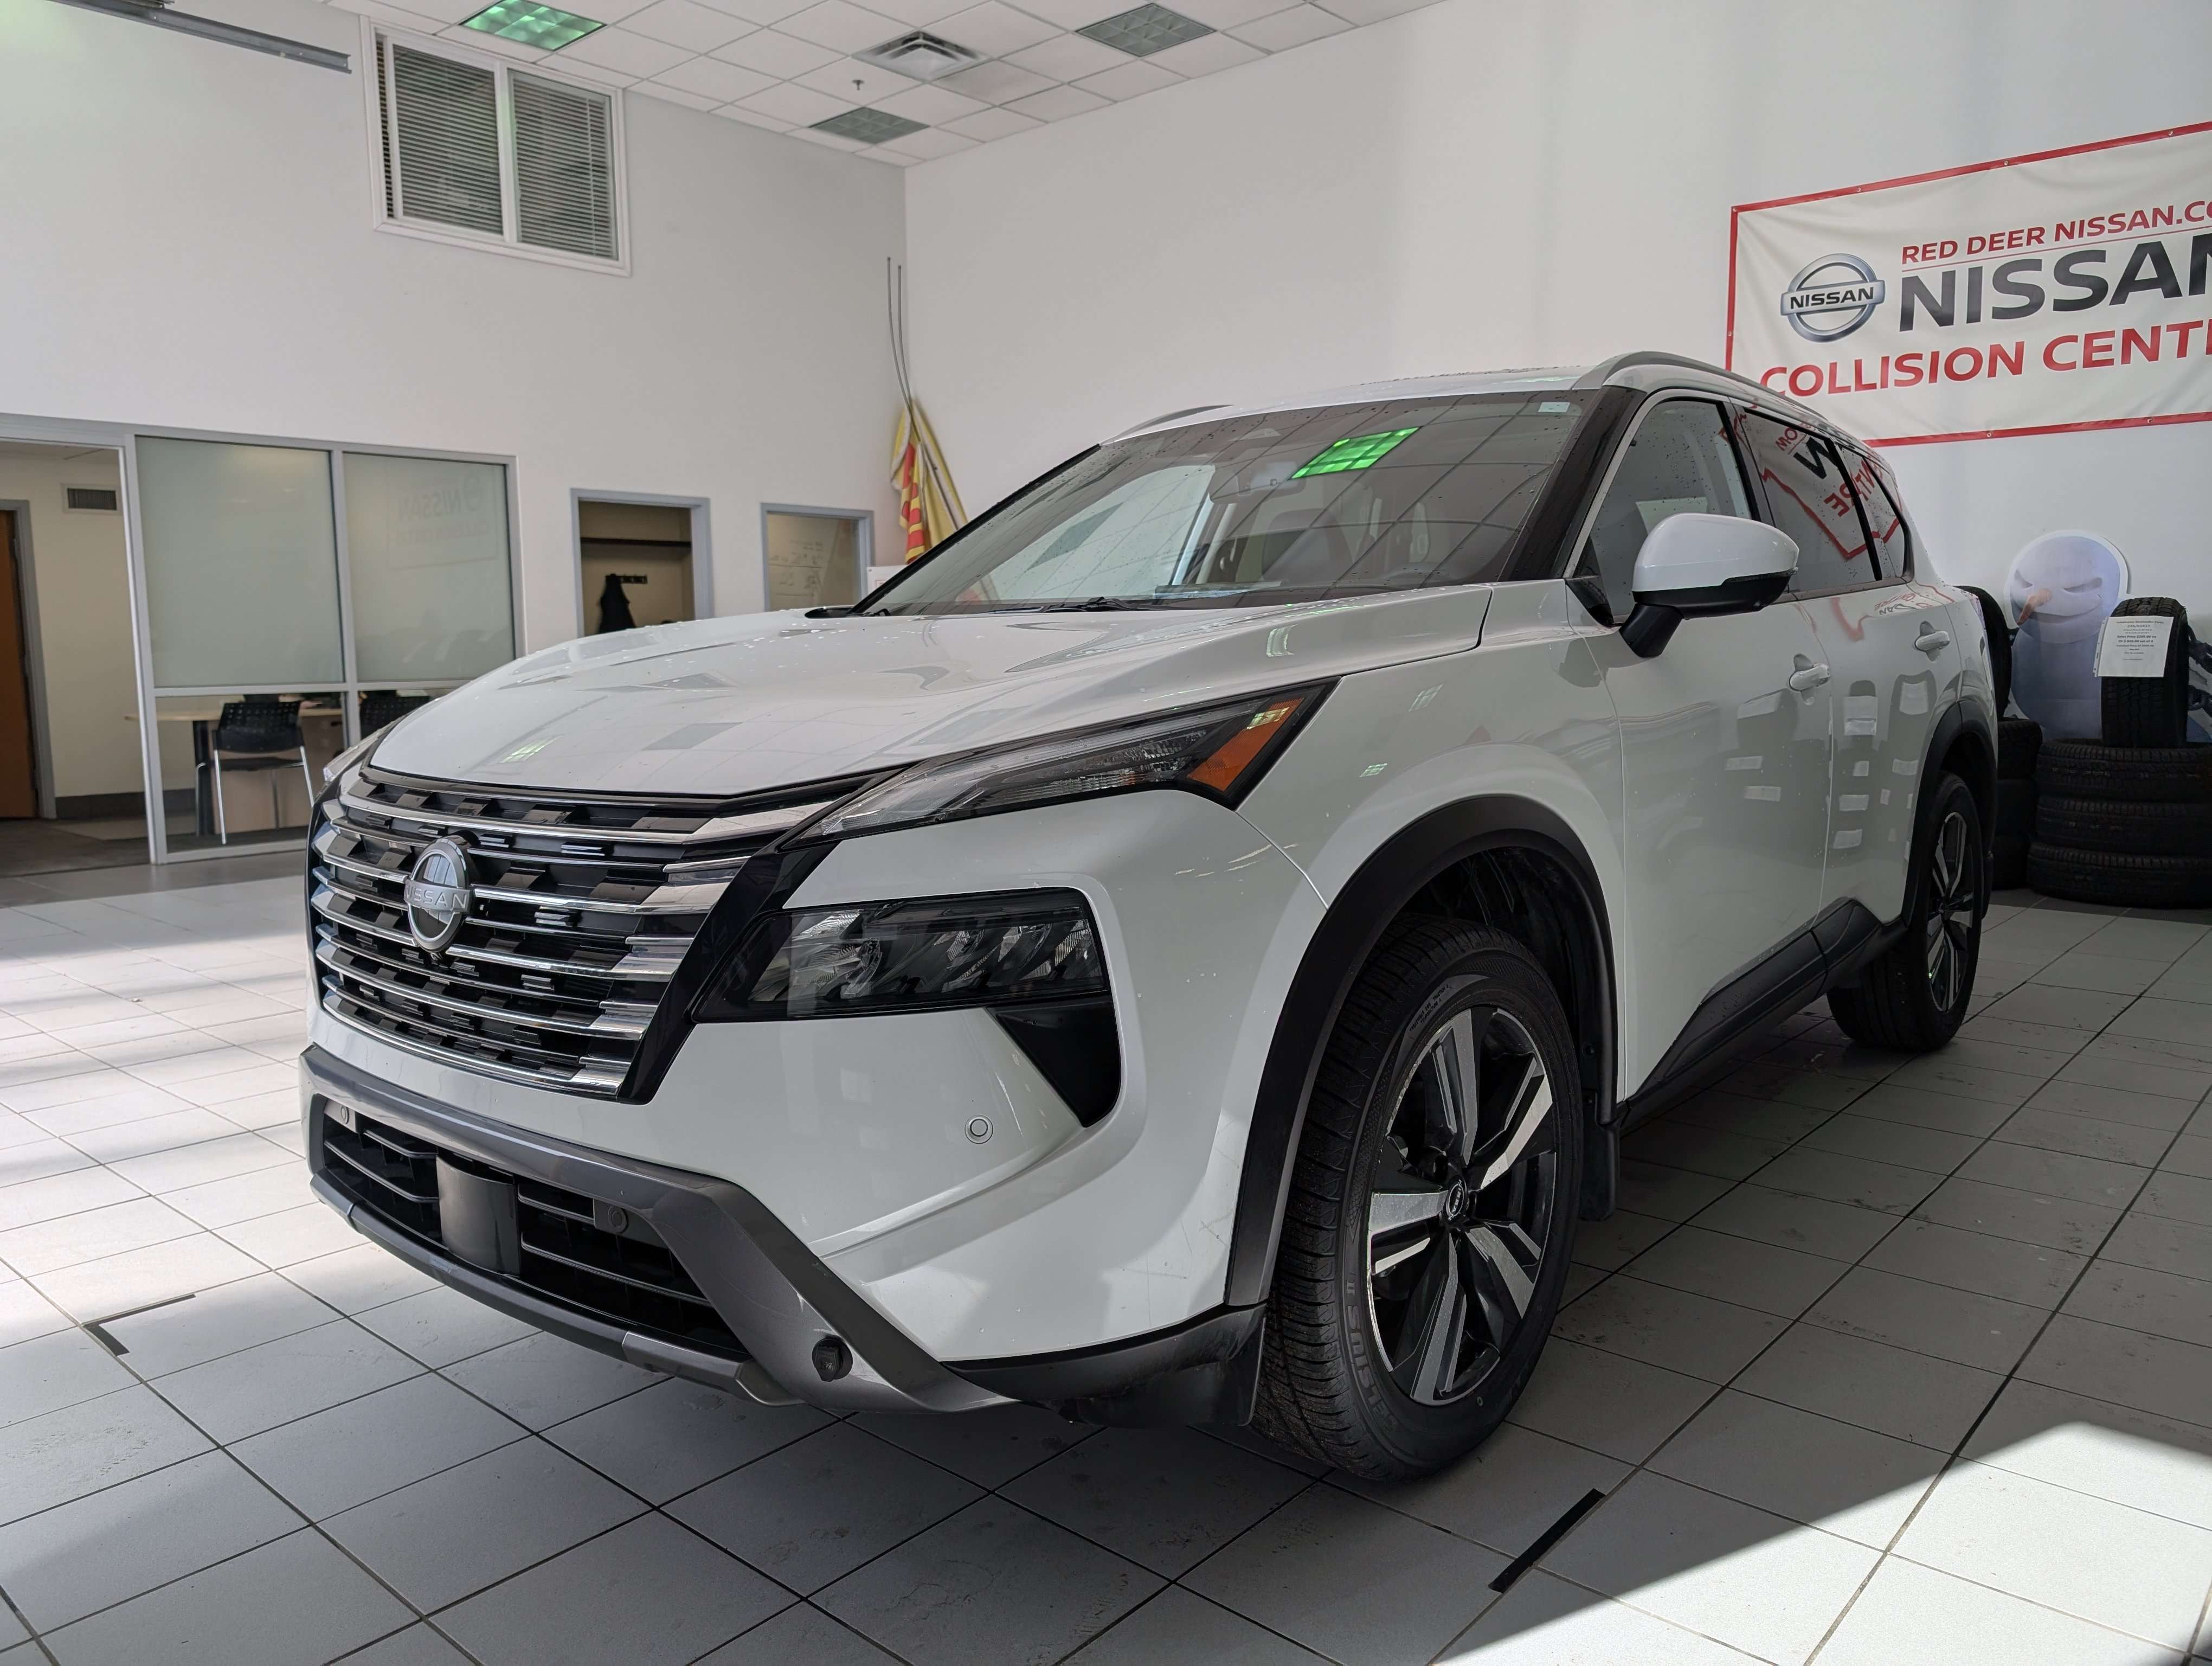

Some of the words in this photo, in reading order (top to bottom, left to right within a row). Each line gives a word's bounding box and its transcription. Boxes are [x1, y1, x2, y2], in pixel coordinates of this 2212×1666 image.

[1902, 240, 1958, 265] RED
[1966, 226, 2046, 255] DEER
[2054, 200, 2212, 242] NISSAN.C
[1790, 286, 1874, 310] NISSAN
[1760, 341, 2025, 397] COLLISION
[2042, 318, 2212, 371] CENT
